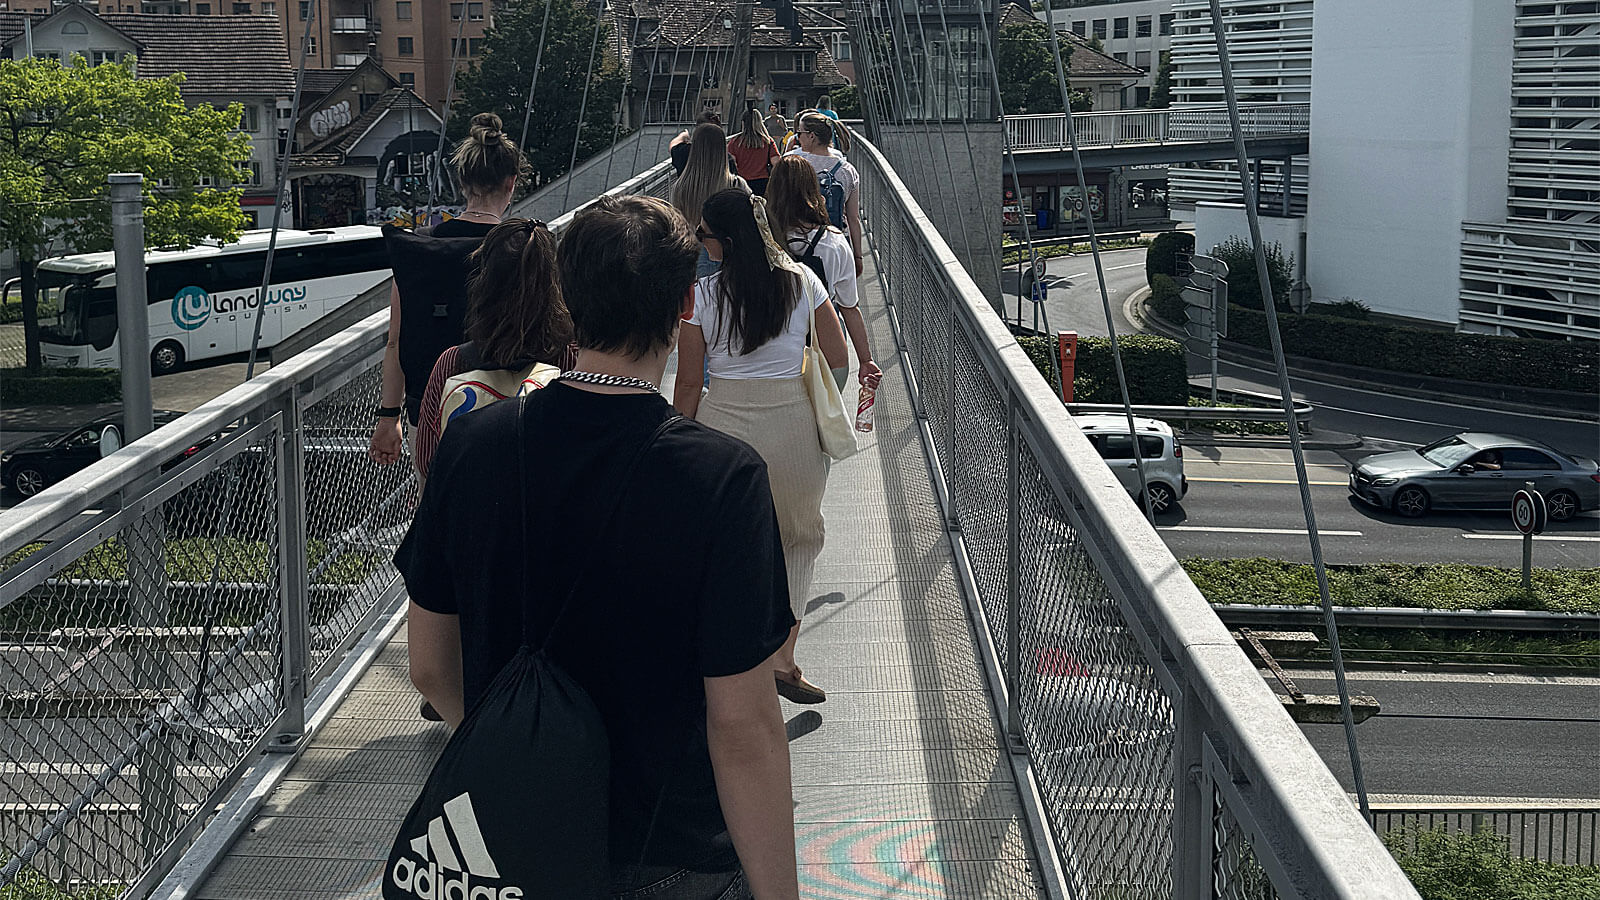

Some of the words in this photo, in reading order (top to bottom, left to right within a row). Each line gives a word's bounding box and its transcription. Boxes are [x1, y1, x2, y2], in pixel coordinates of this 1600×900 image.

[213, 285, 307, 314] landway
[214, 303, 308, 323] TOUISM
[1518, 504, 1528, 520] 60
